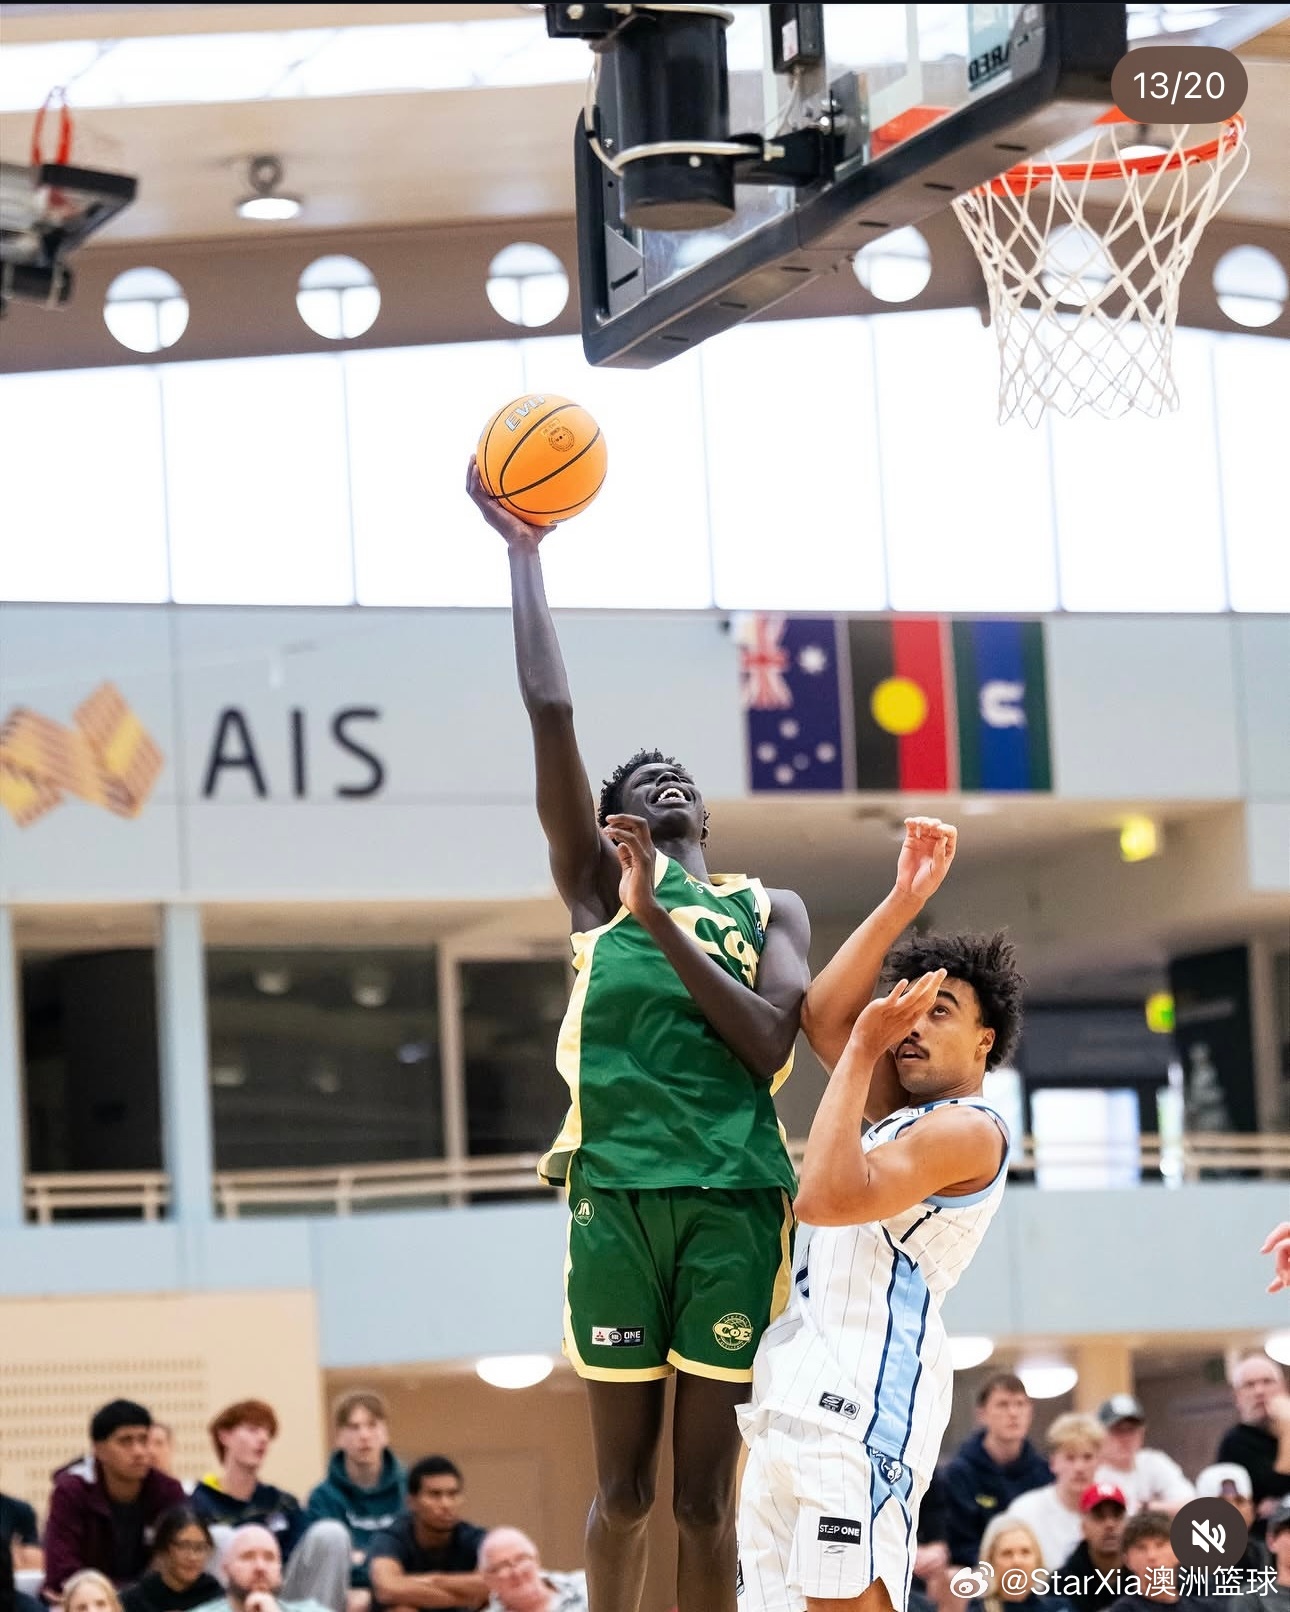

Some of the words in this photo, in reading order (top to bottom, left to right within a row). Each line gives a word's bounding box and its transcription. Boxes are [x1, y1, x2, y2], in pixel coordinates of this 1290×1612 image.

[203, 707, 386, 800] AIS
[623, 1330, 641, 1340] ONE
[819, 1524, 840, 1534] STEP
[841, 1526, 860, 1537] ONE
